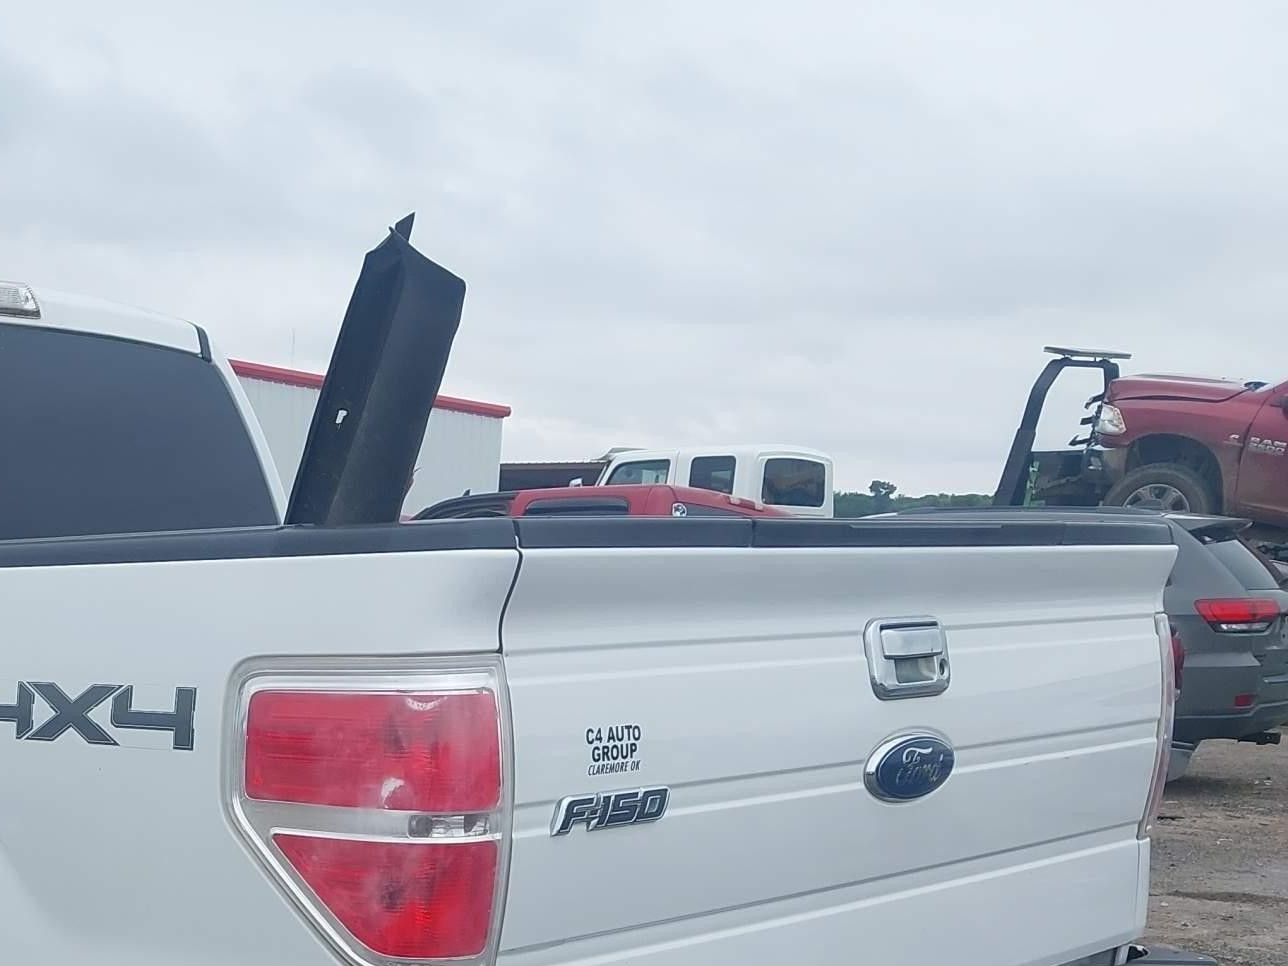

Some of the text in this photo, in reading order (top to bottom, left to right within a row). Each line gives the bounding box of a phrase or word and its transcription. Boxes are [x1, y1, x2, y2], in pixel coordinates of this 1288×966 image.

[586, 725, 641, 745] C4 AUTO
[592, 743, 637, 762] GROUP
[588, 760, 641, 776] CLAREMORE OK
[895, 746, 945, 786] Ford
